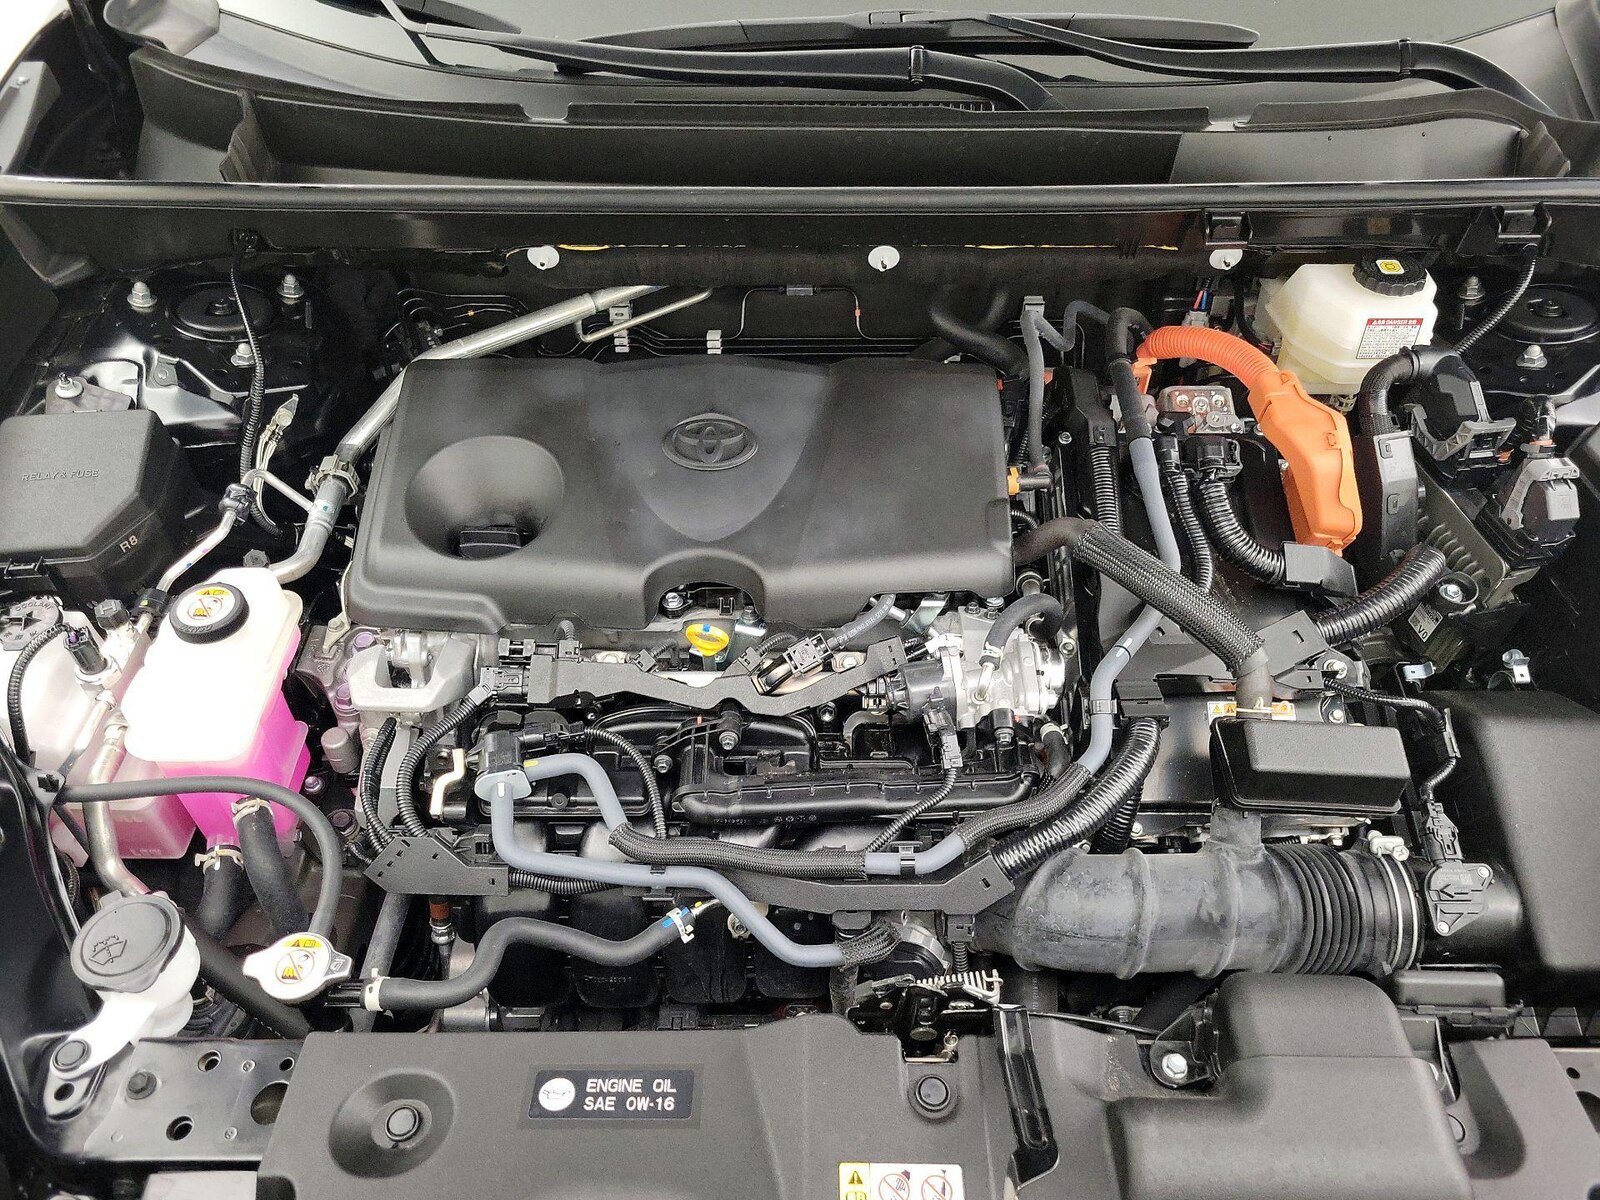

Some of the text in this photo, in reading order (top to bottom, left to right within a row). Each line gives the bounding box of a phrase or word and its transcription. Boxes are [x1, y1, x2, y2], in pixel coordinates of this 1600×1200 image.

[70, 469, 100, 479] FUSE
[119, 535, 138, 553] R8
[585, 1078, 677, 1093] ENGINE OIL
[583, 1096, 675, 1111] SAE 0W-16
